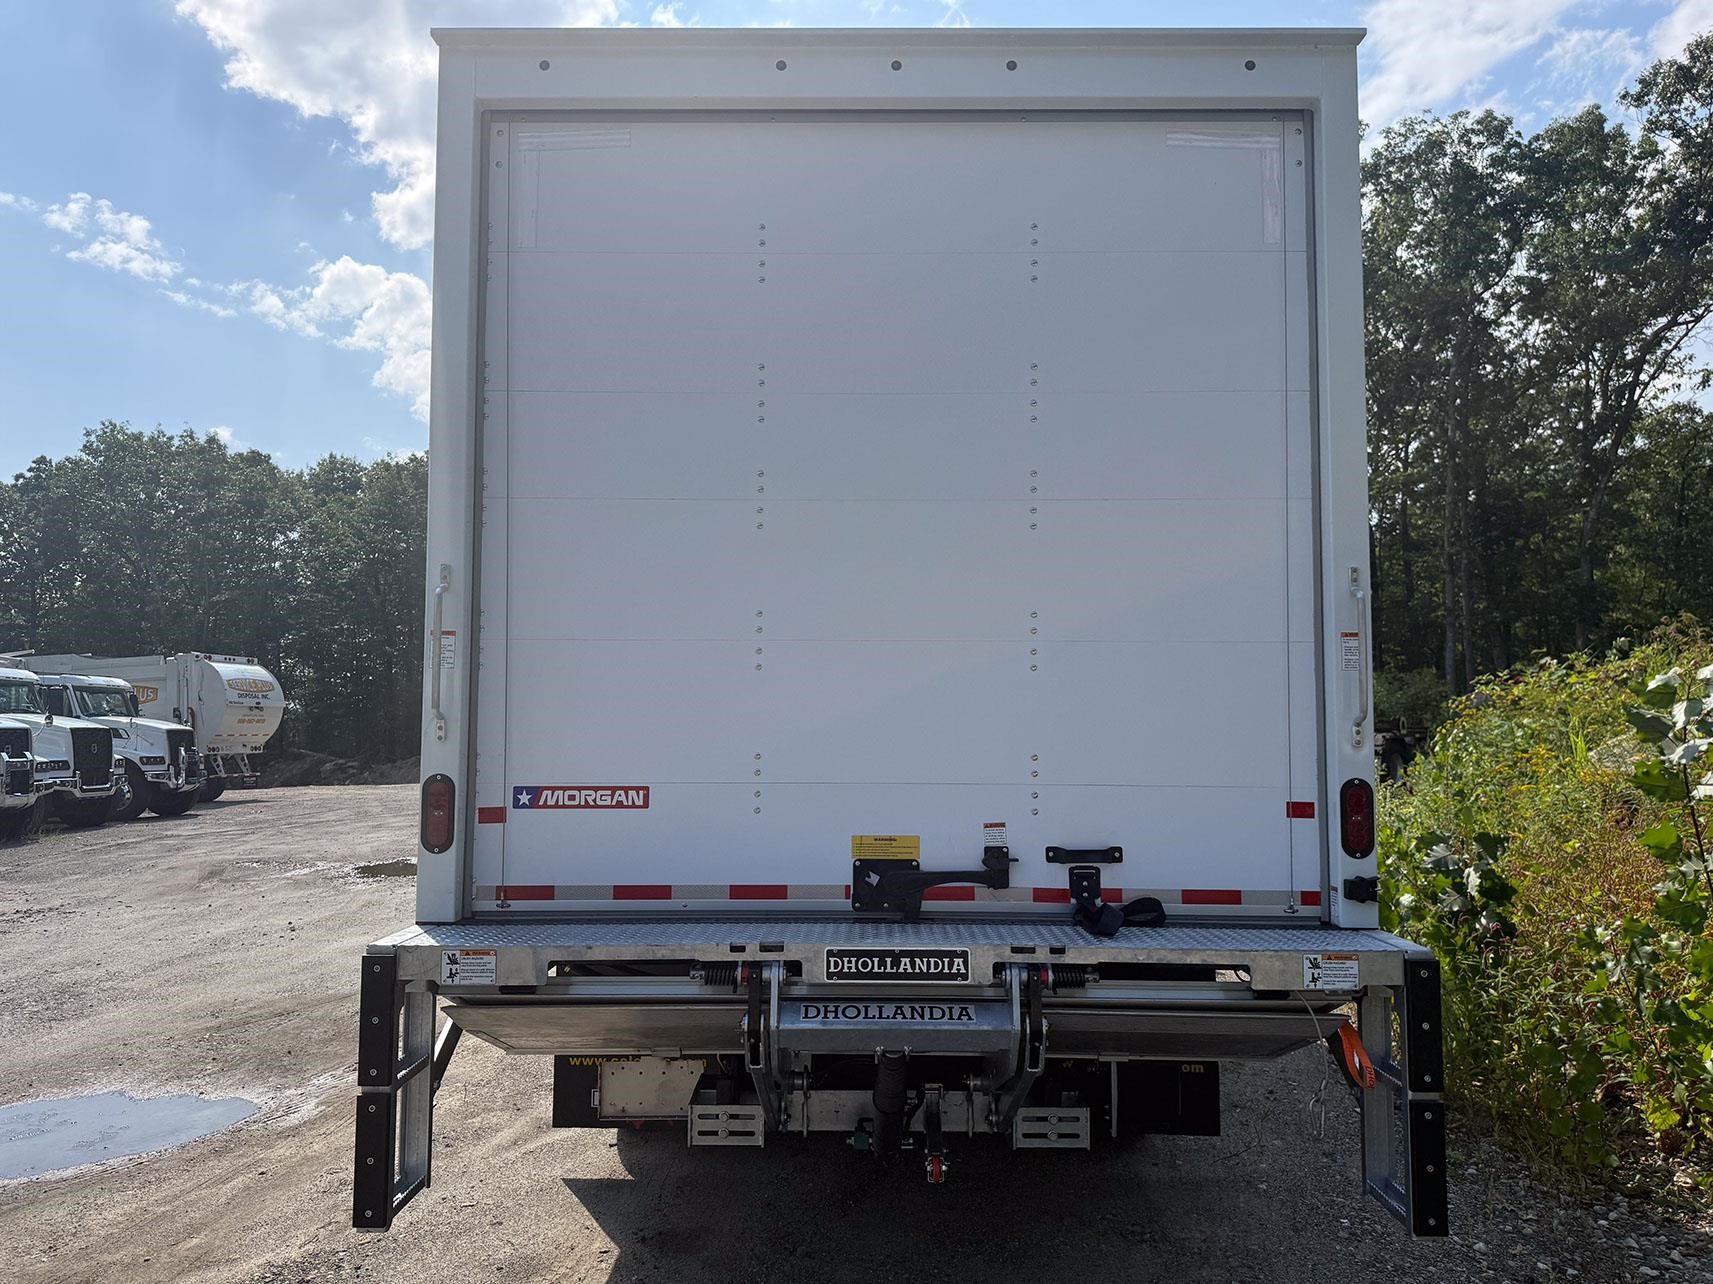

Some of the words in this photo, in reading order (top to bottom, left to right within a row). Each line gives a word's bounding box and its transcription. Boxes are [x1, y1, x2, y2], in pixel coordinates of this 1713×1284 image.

[539, 790, 643, 806] MORGAN
[829, 957, 966, 973] DHOLLANDIA
[802, 1005, 974, 1021] DHOLLANDIA
